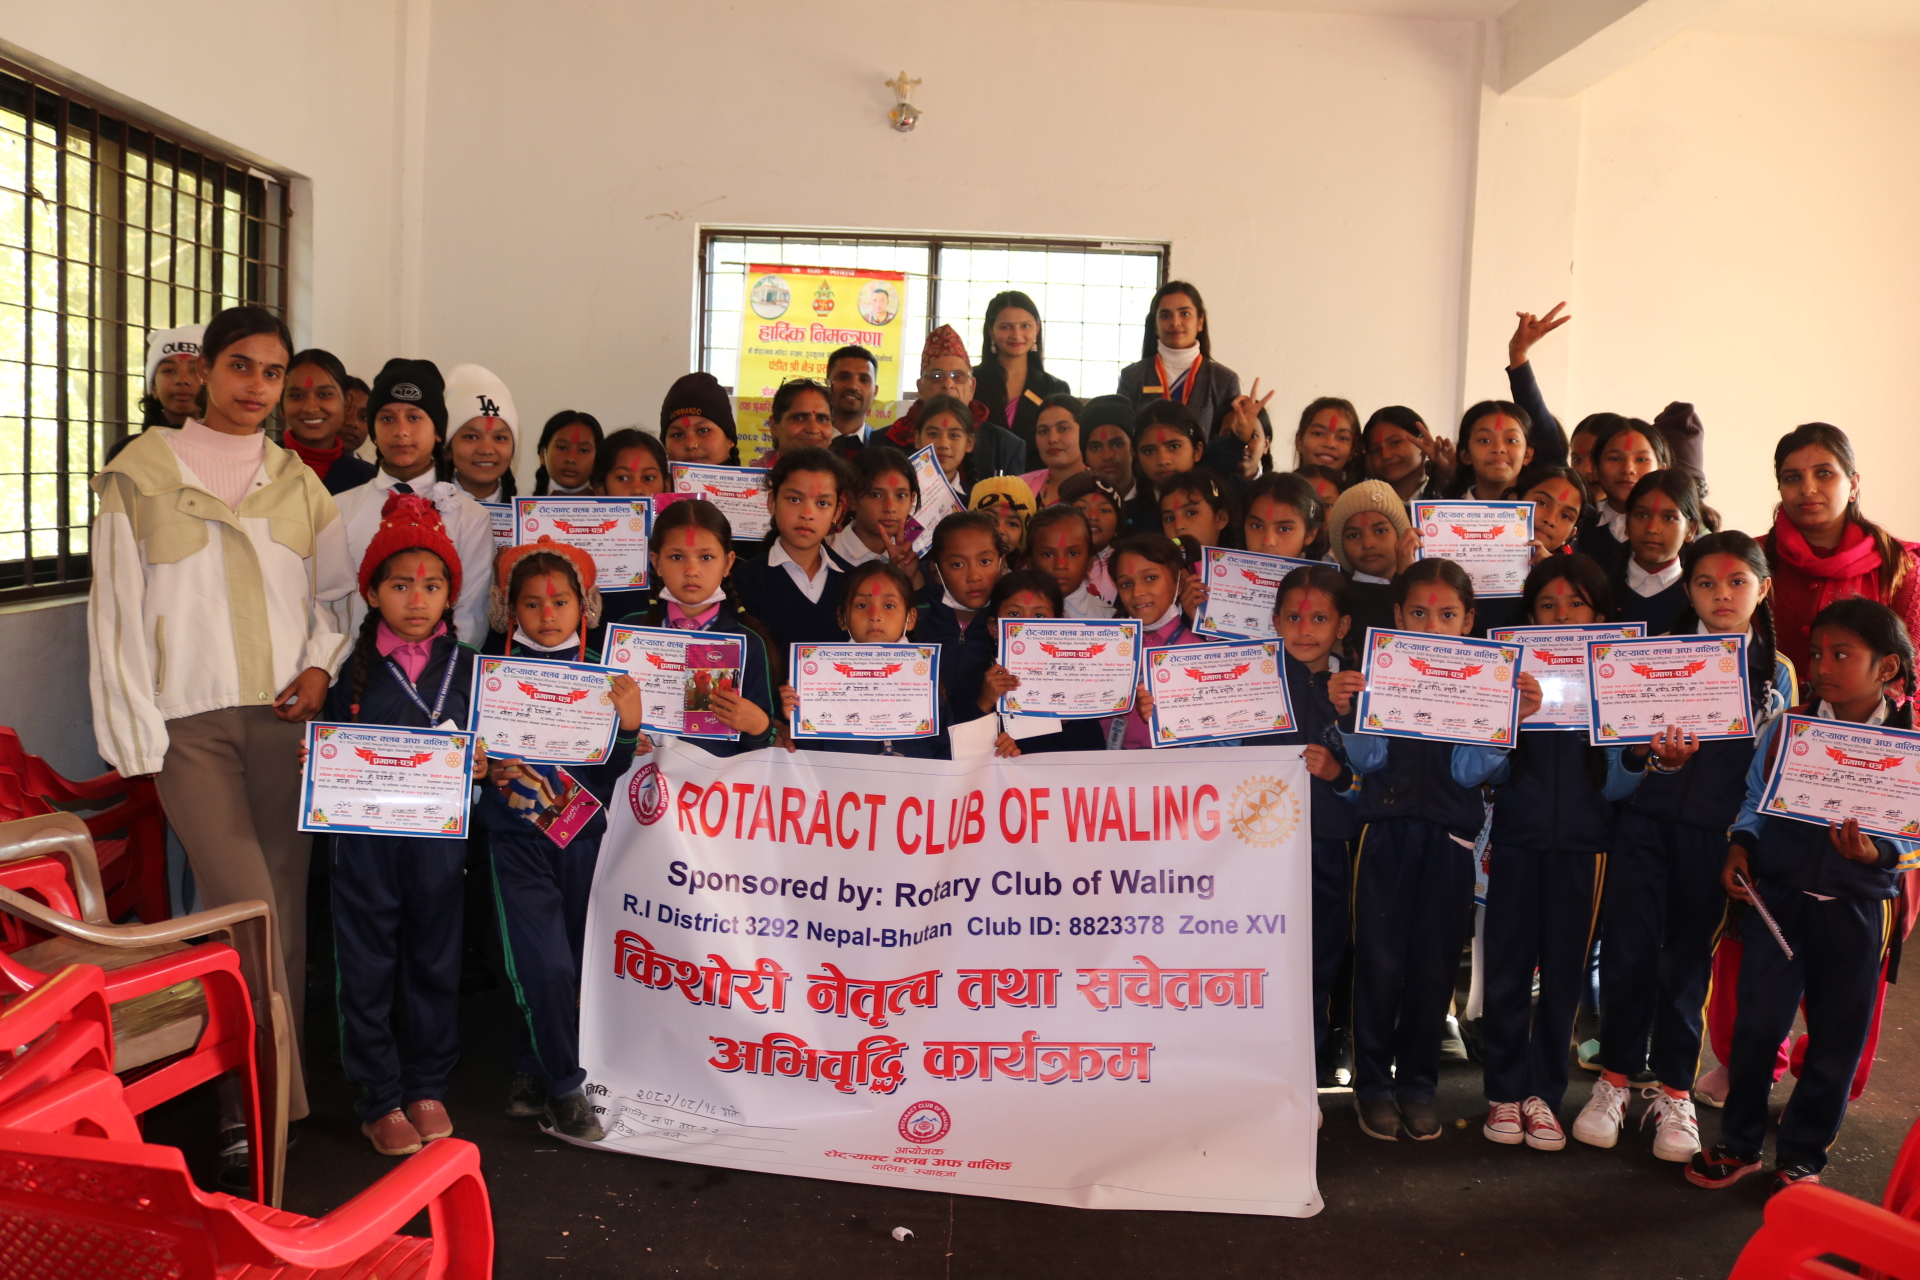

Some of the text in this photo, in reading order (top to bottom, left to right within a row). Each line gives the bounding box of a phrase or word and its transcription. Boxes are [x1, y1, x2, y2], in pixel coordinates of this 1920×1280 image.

[759, 321, 806, 342] हार्दिक
[163, 342, 199, 354] QUEEN
[670, 407, 701, 419] COMMANDO
[1201, 673, 1236, 682] प्रमाण-पत्र
[1425, 669, 1464, 679] प्रमाण-पत्र
[534, 693, 571, 703] प्रमाण-पत्र
[373, 757, 414, 767] प्रमाण-पत्र
[1842, 758, 1883, 770] प्रमाण-पत्र
[677, 780, 1221, 855] ROTARACT CLUB OF WALING
[667, 861, 1215, 911] Sponsored by: Rotary Club of Waling
[623, 893, 1286, 948] R.I District 3292 Nepal-Bhutan Club ID: 8823378 Zone XVI
[614, 929, 1269, 1029] किशोरी नेतृत्व तथा सचेतना
[923, 1030, 1155, 1086] कार्यक्रम
[895, 1146, 945, 1155] आयोजक
[893, 1156, 927, 1166] क्लब
[932, 1158, 964, 1168] अफ
[967, 1159, 1012, 1171] वालिङ
